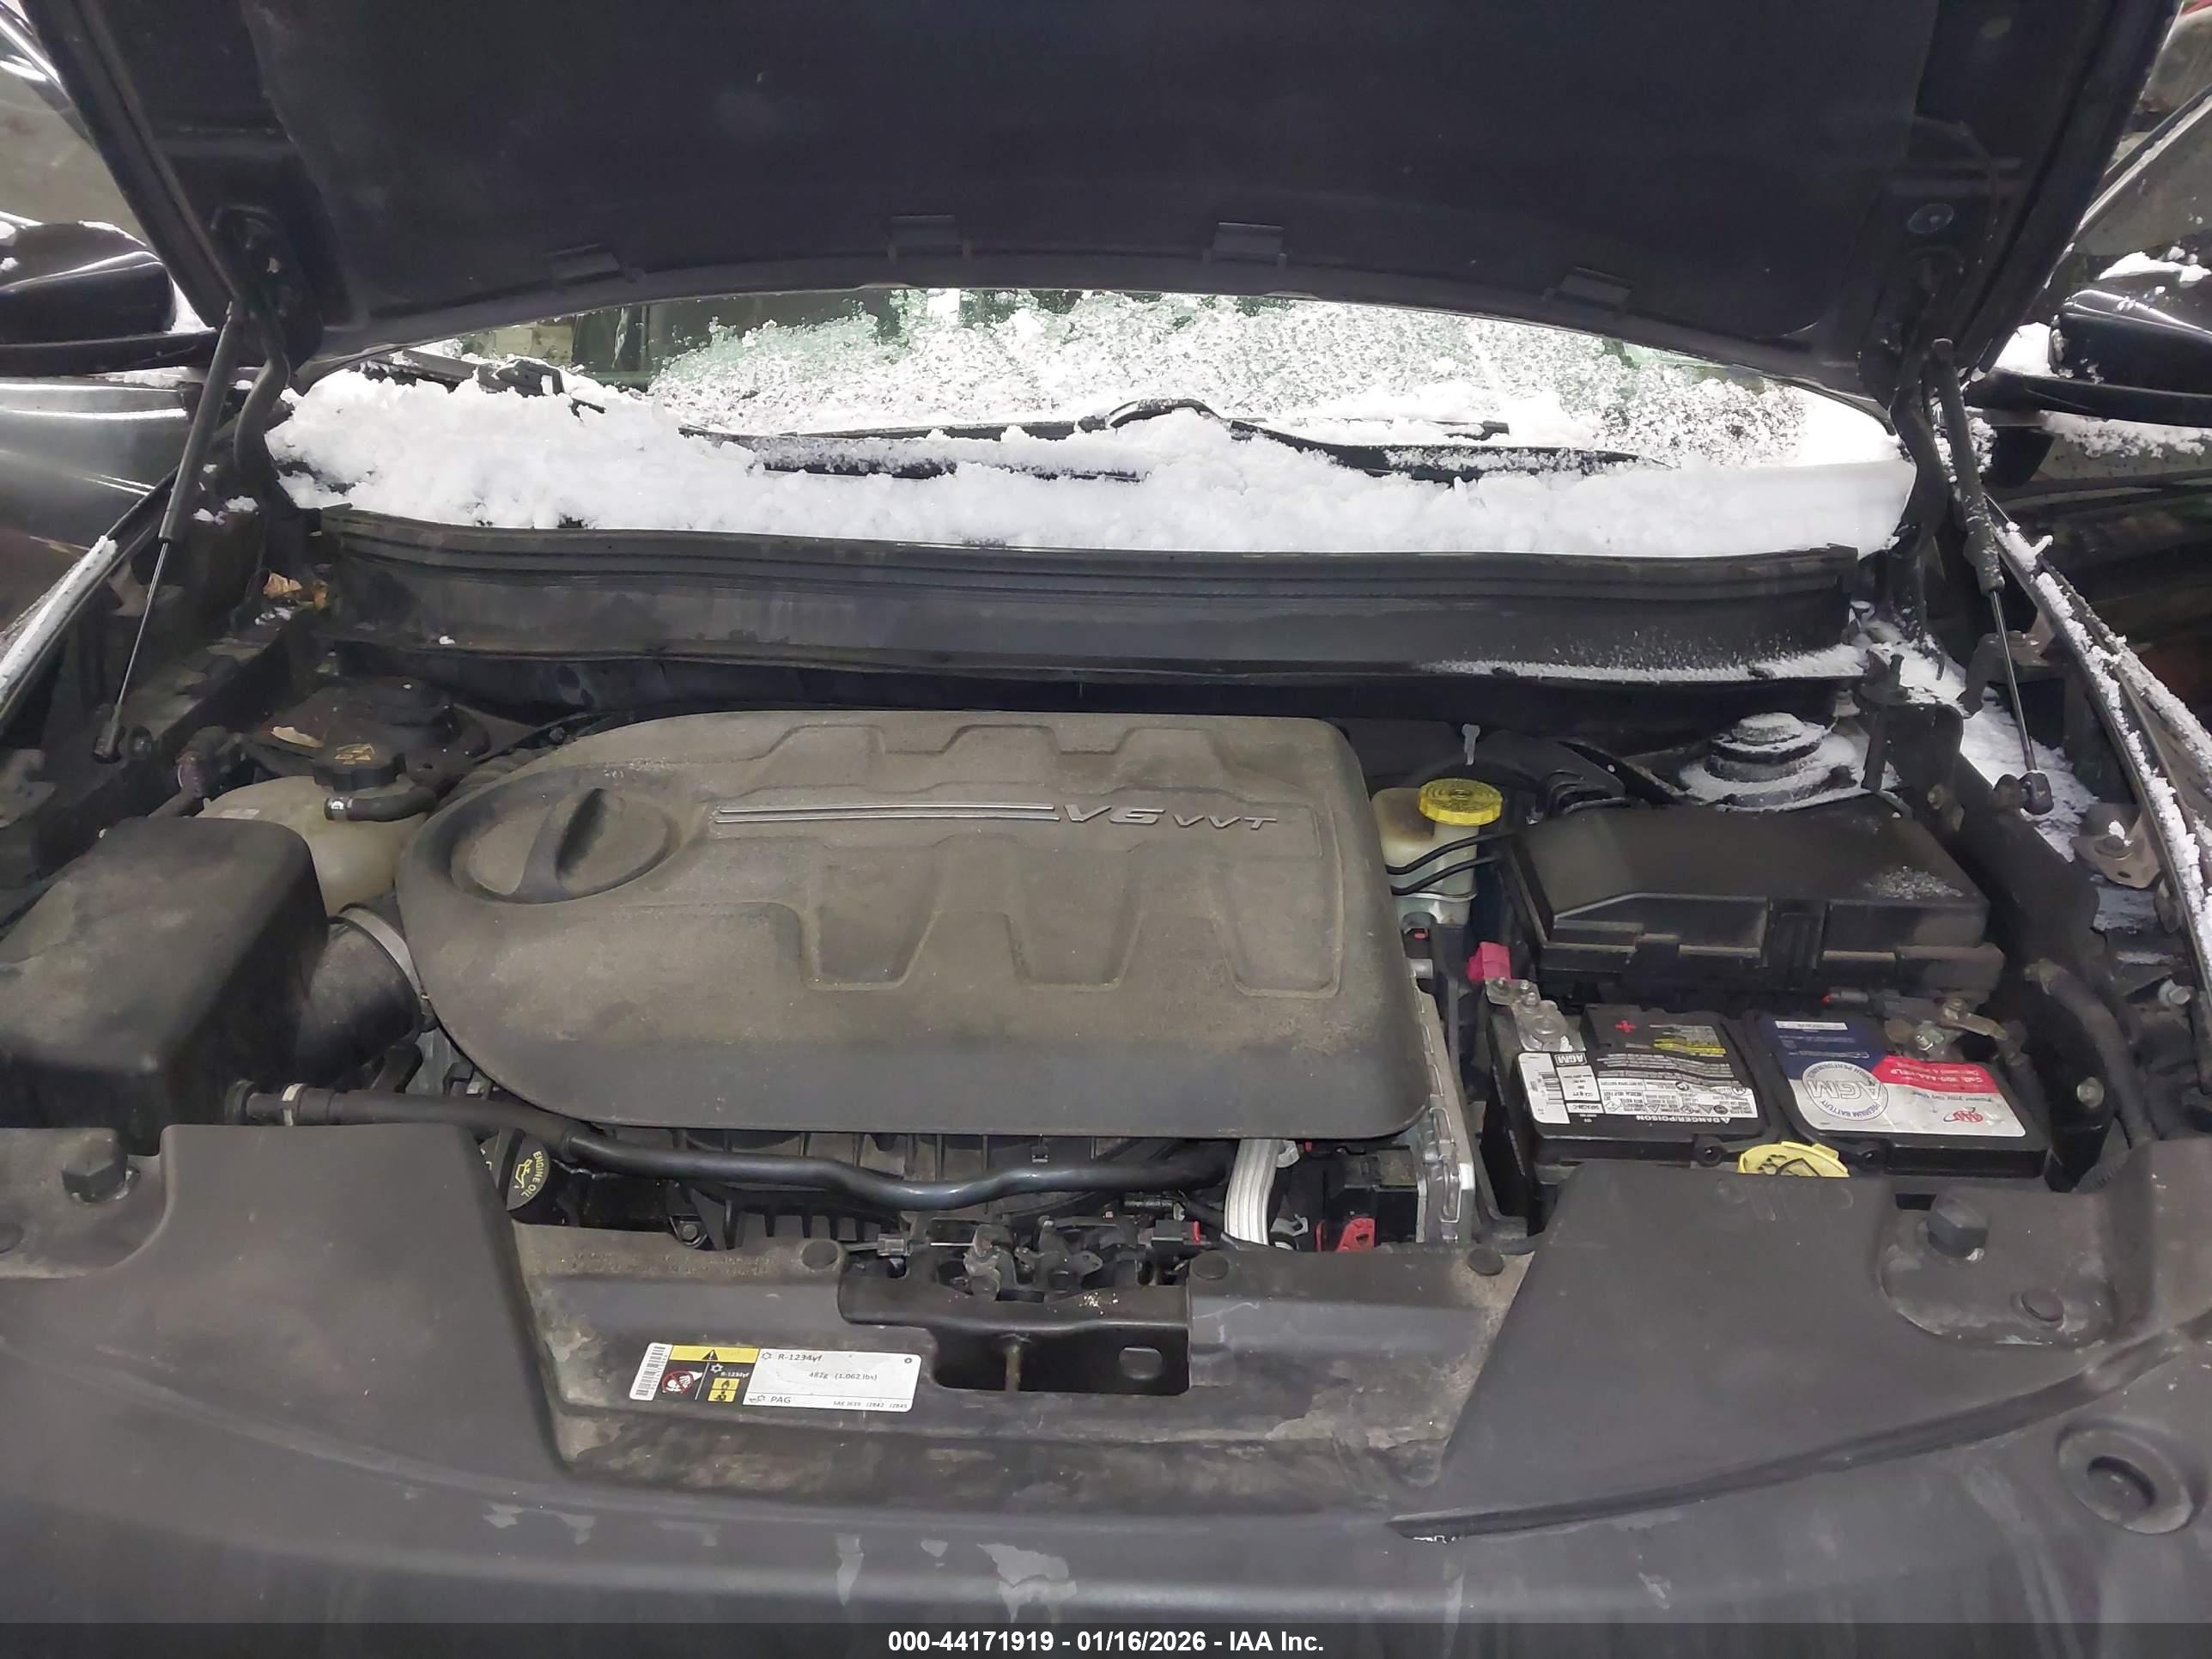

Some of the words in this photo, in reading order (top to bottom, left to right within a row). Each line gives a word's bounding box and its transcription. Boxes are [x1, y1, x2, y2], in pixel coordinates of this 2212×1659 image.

[1065, 804, 1166, 824] V6
[1174, 814, 1278, 830] VVT
[1558, 1054, 1583, 1063] AGM
[1808, 1079, 1881, 1100] AGM
[1820, 1100, 1851, 1117] BATTERY
[532, 1151, 544, 1183] ENGINE
[520, 1184, 537, 1198] OIL
[835, 1372, 861, 1381] (1.062
